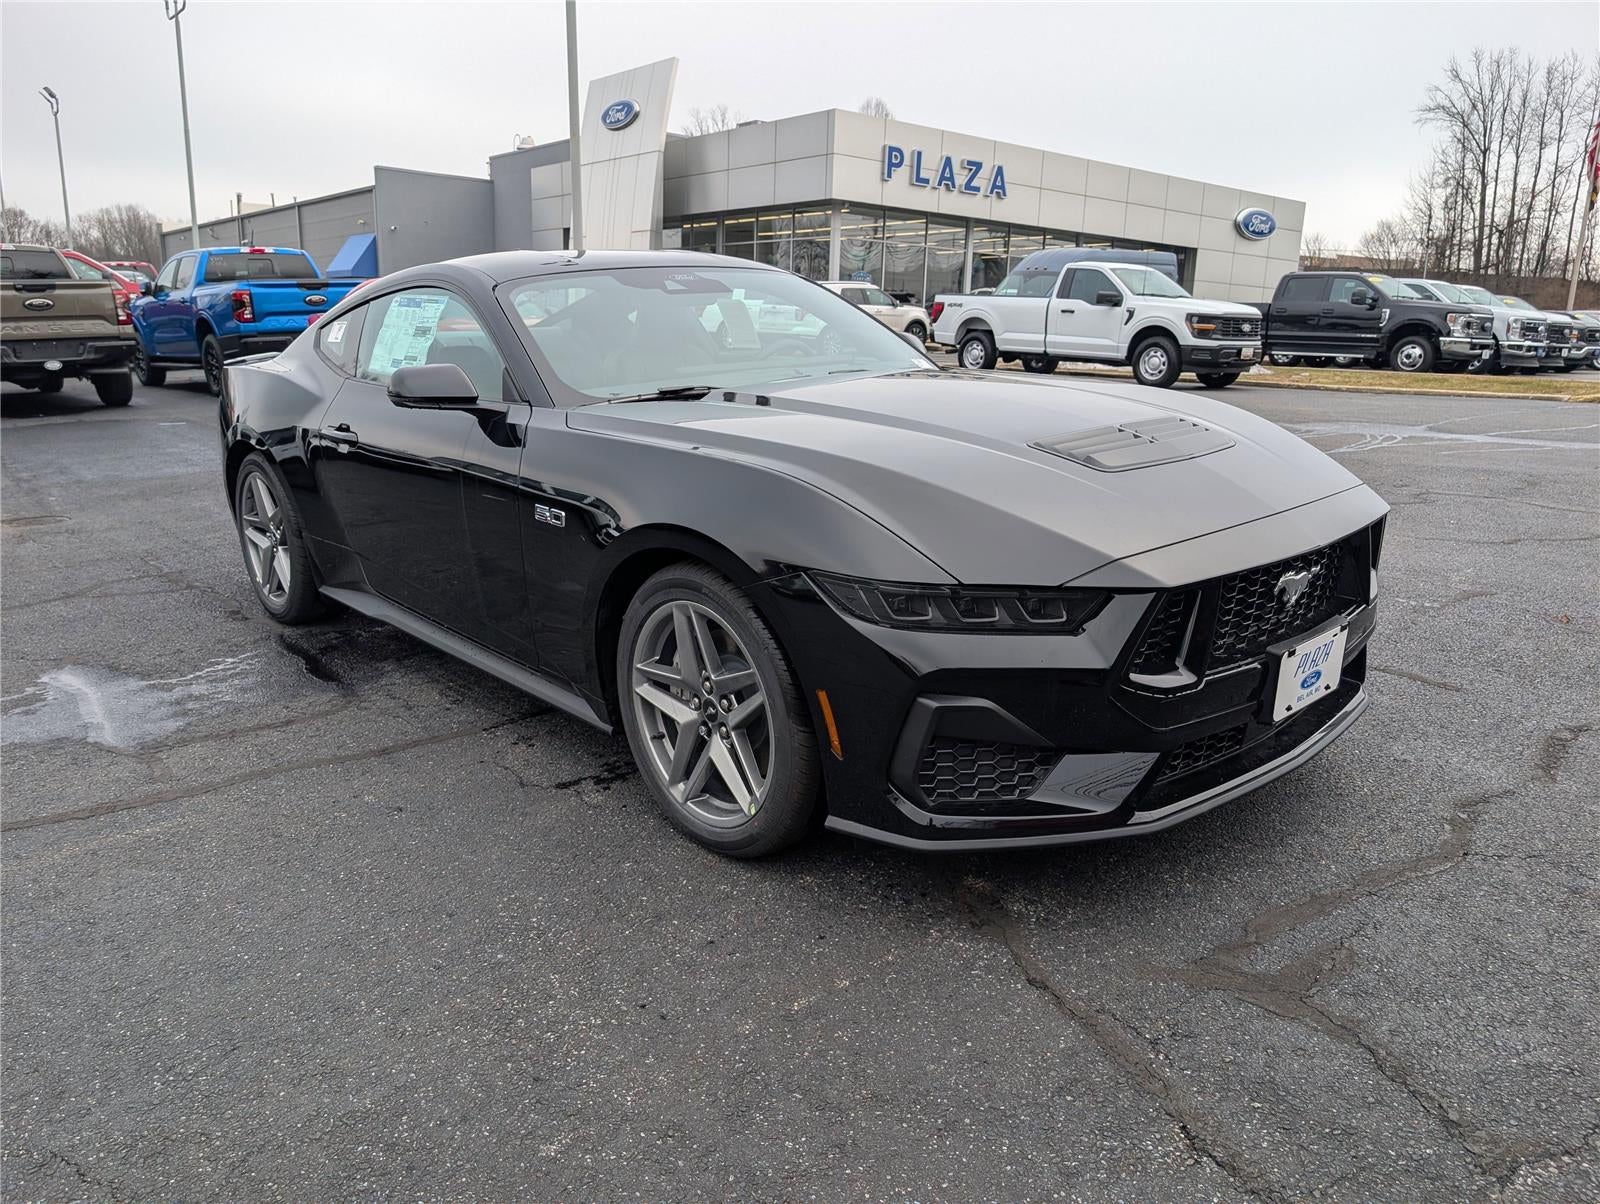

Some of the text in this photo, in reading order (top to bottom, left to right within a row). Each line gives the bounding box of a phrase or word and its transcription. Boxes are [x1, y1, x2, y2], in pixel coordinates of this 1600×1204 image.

[606, 105, 628, 123] Ford
[882, 144, 1007, 199] PLAZA
[1248, 214, 1271, 233] Ford
[1293, 640, 1334, 678] PLAZA
